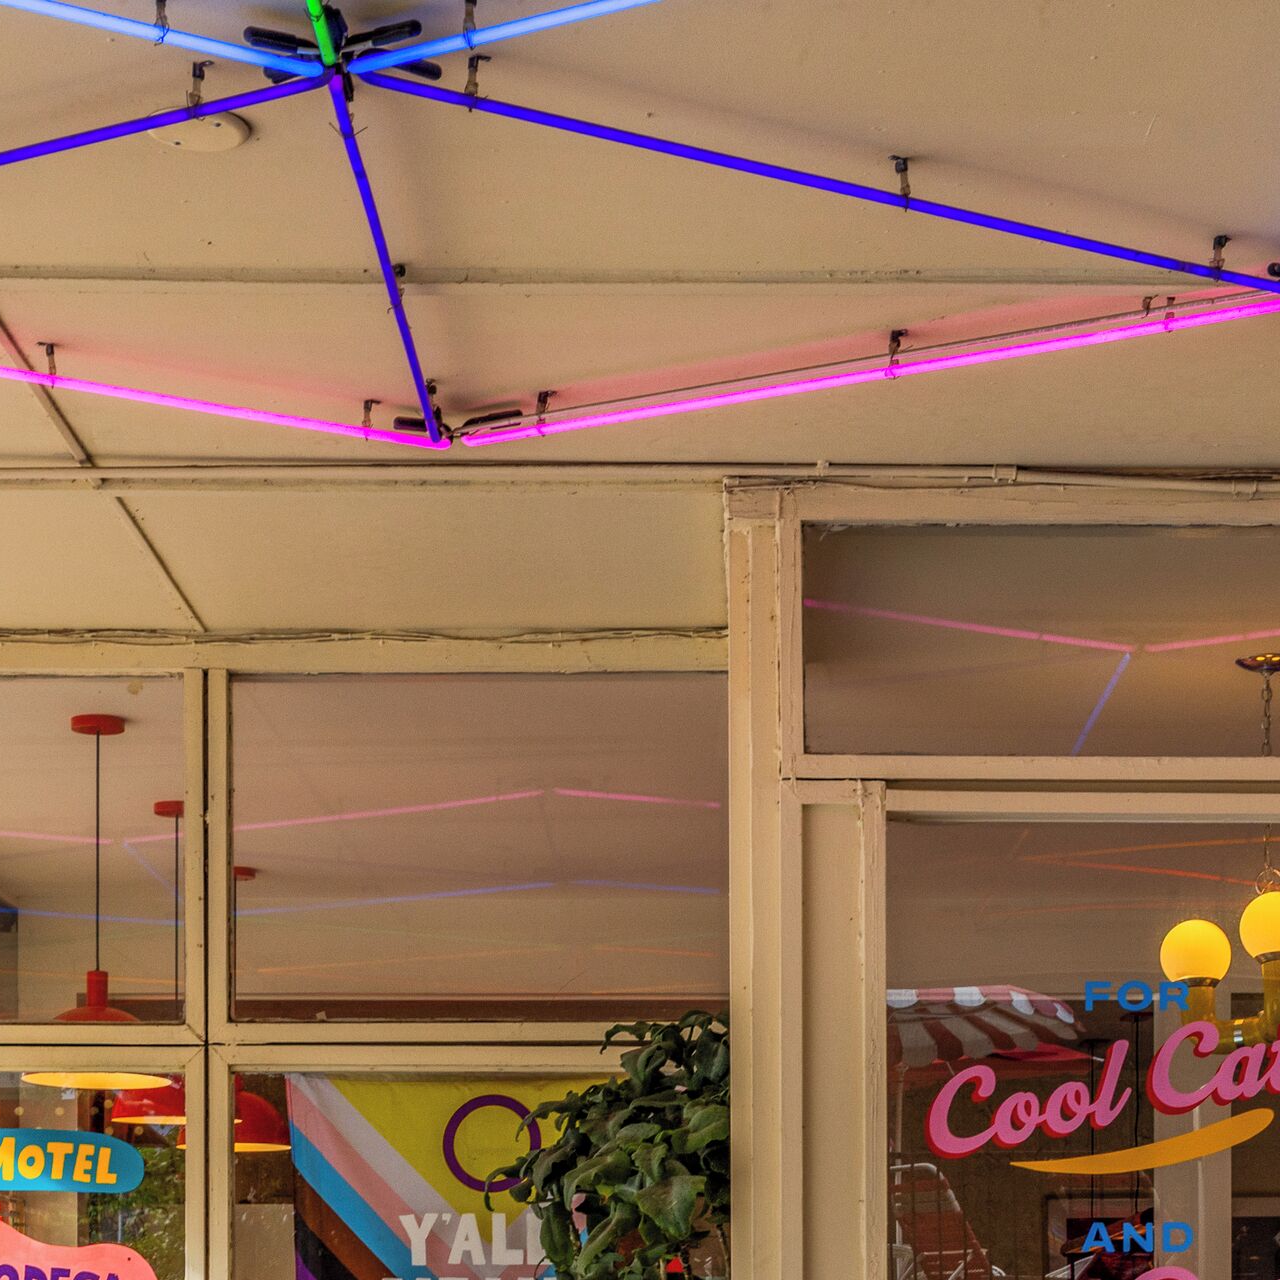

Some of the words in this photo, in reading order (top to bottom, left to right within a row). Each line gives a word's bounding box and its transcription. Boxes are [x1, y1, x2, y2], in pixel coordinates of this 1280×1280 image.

[1083, 980, 1190, 1012] FOR
[924, 1039, 1132, 1160] Cool
[398, 1212, 554, 1267] Y'ALL
[1080, 1221, 1194, 1254] AND
